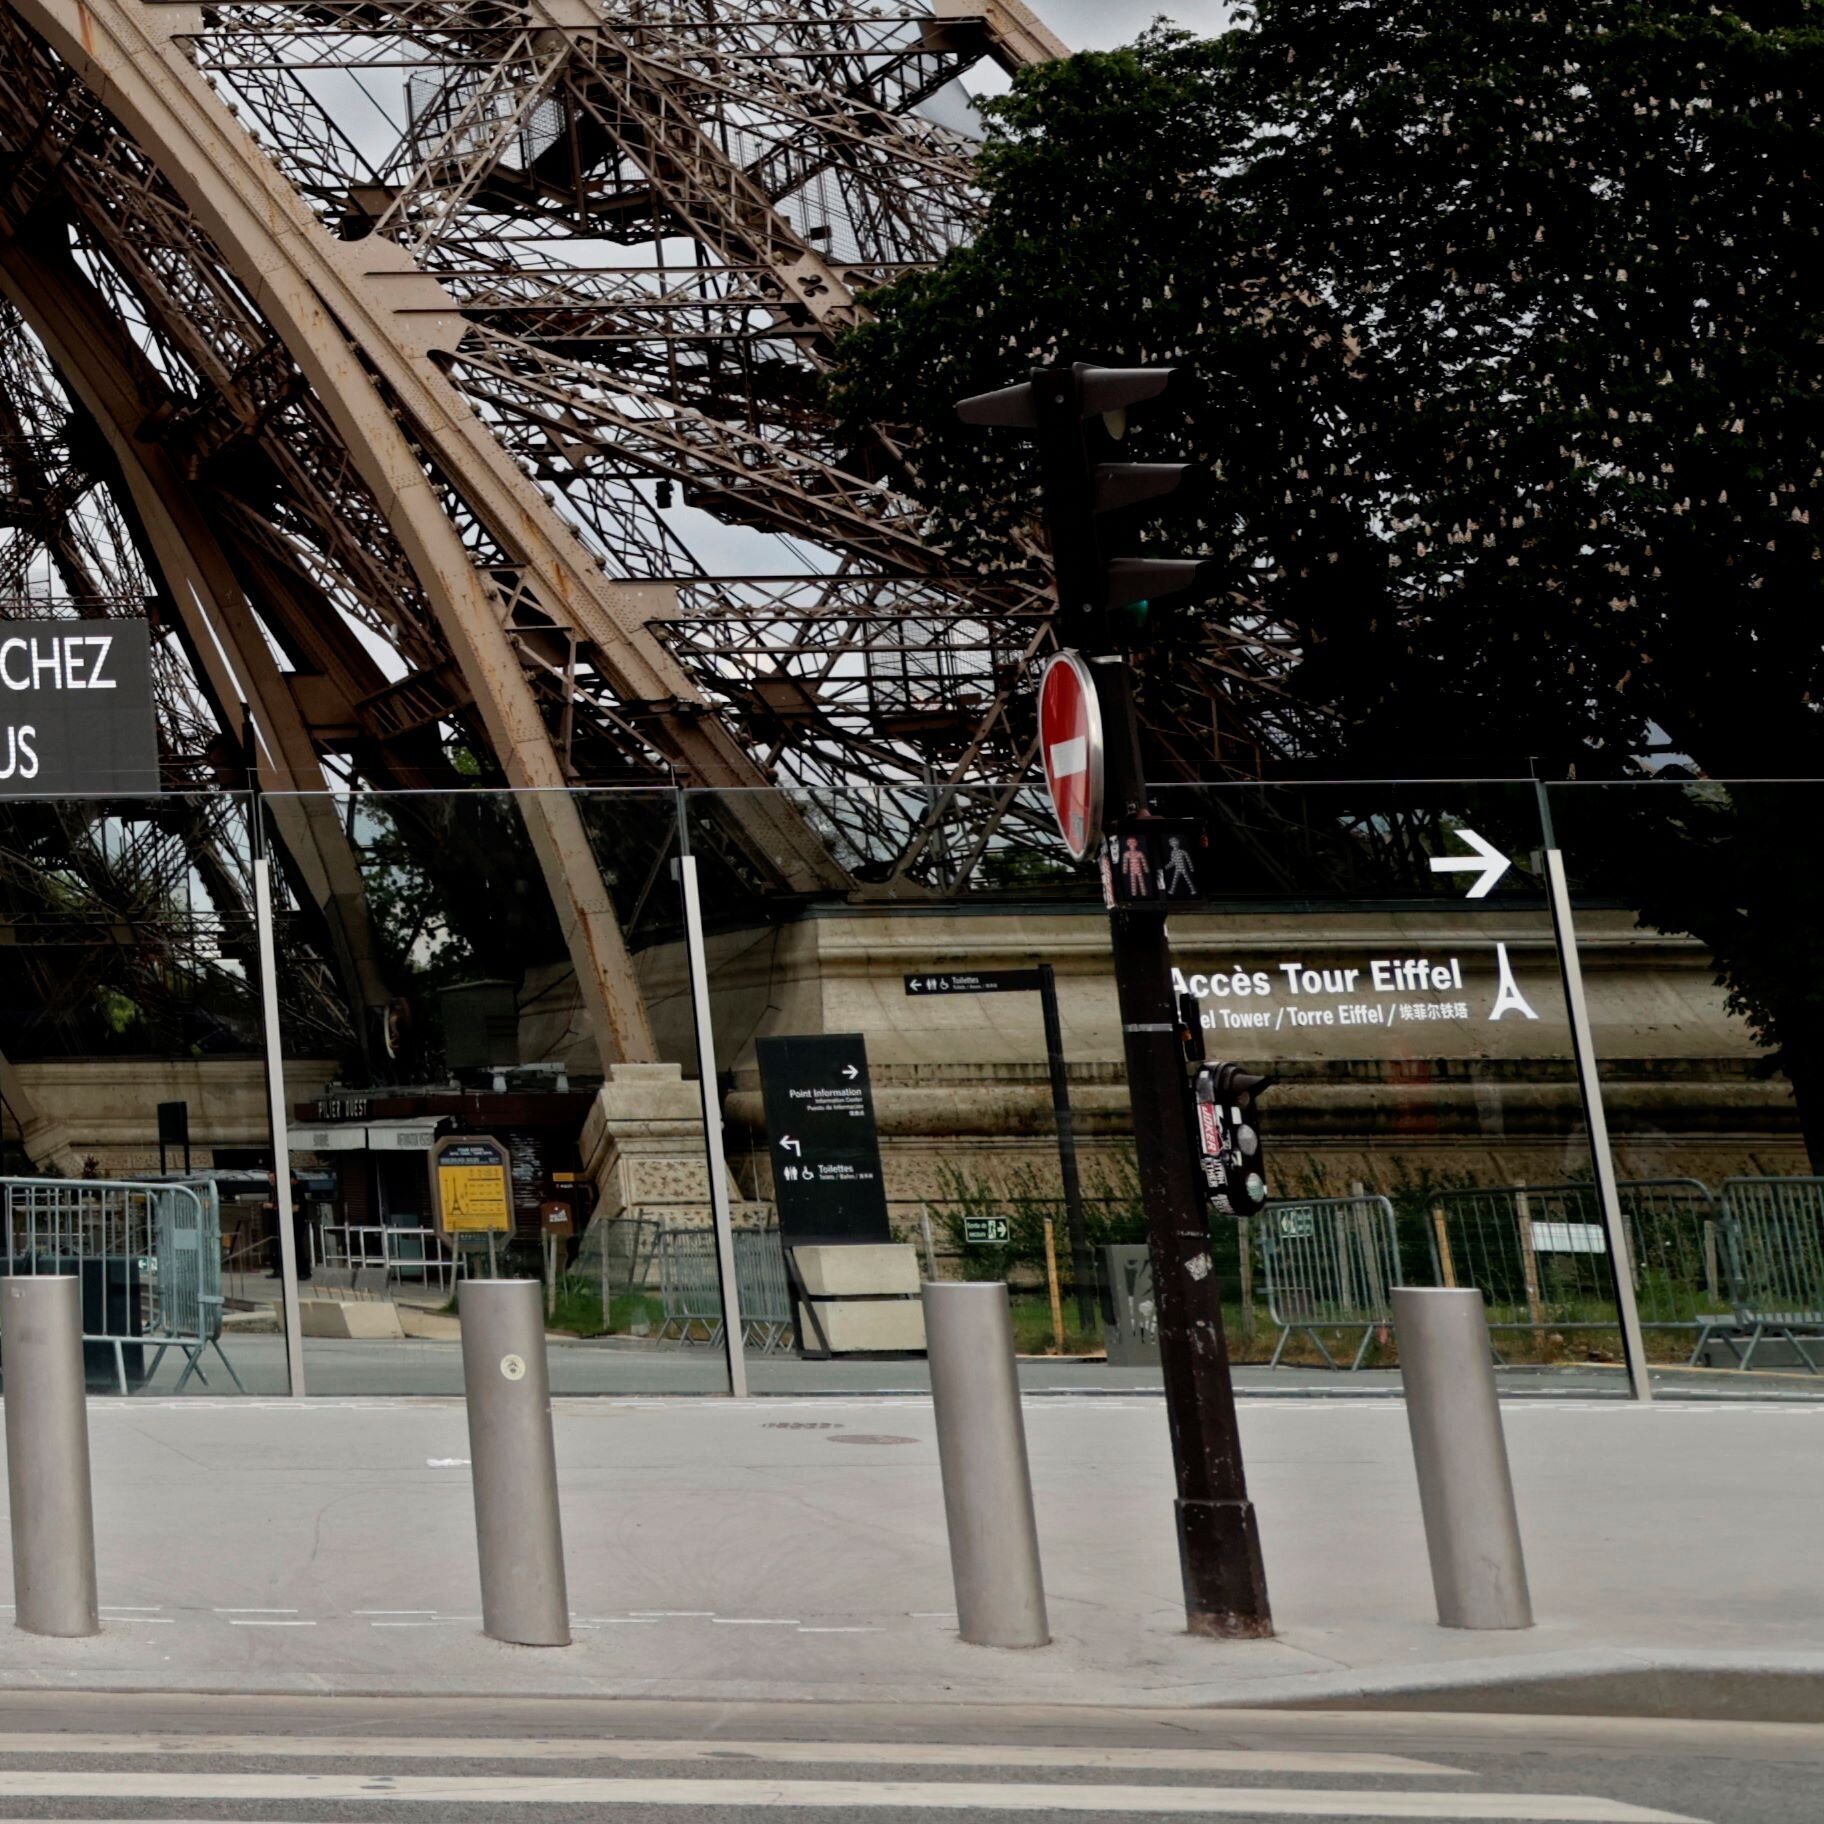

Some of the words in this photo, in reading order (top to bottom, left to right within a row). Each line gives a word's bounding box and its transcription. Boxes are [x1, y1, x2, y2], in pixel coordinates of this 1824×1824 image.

[0, 636, 117, 690] CHEZ
[1170, 965, 1271, 998] Accès
[1280, 963, 1359, 994] Tour
[1371, 958, 1462, 991] Eiffel
[1220, 1009, 1271, 1029] Tower
[1287, 1006, 1335, 1026] Torre
[1338, 1004, 1384, 1025] Eiffel
[1399, 1003, 1468, 1020] 埃菲尔铁塔
[789, 1089, 811, 1098] Point
[813, 1088, 862, 1097] Information
[1202, 1106, 1218, 1152] JOKER
